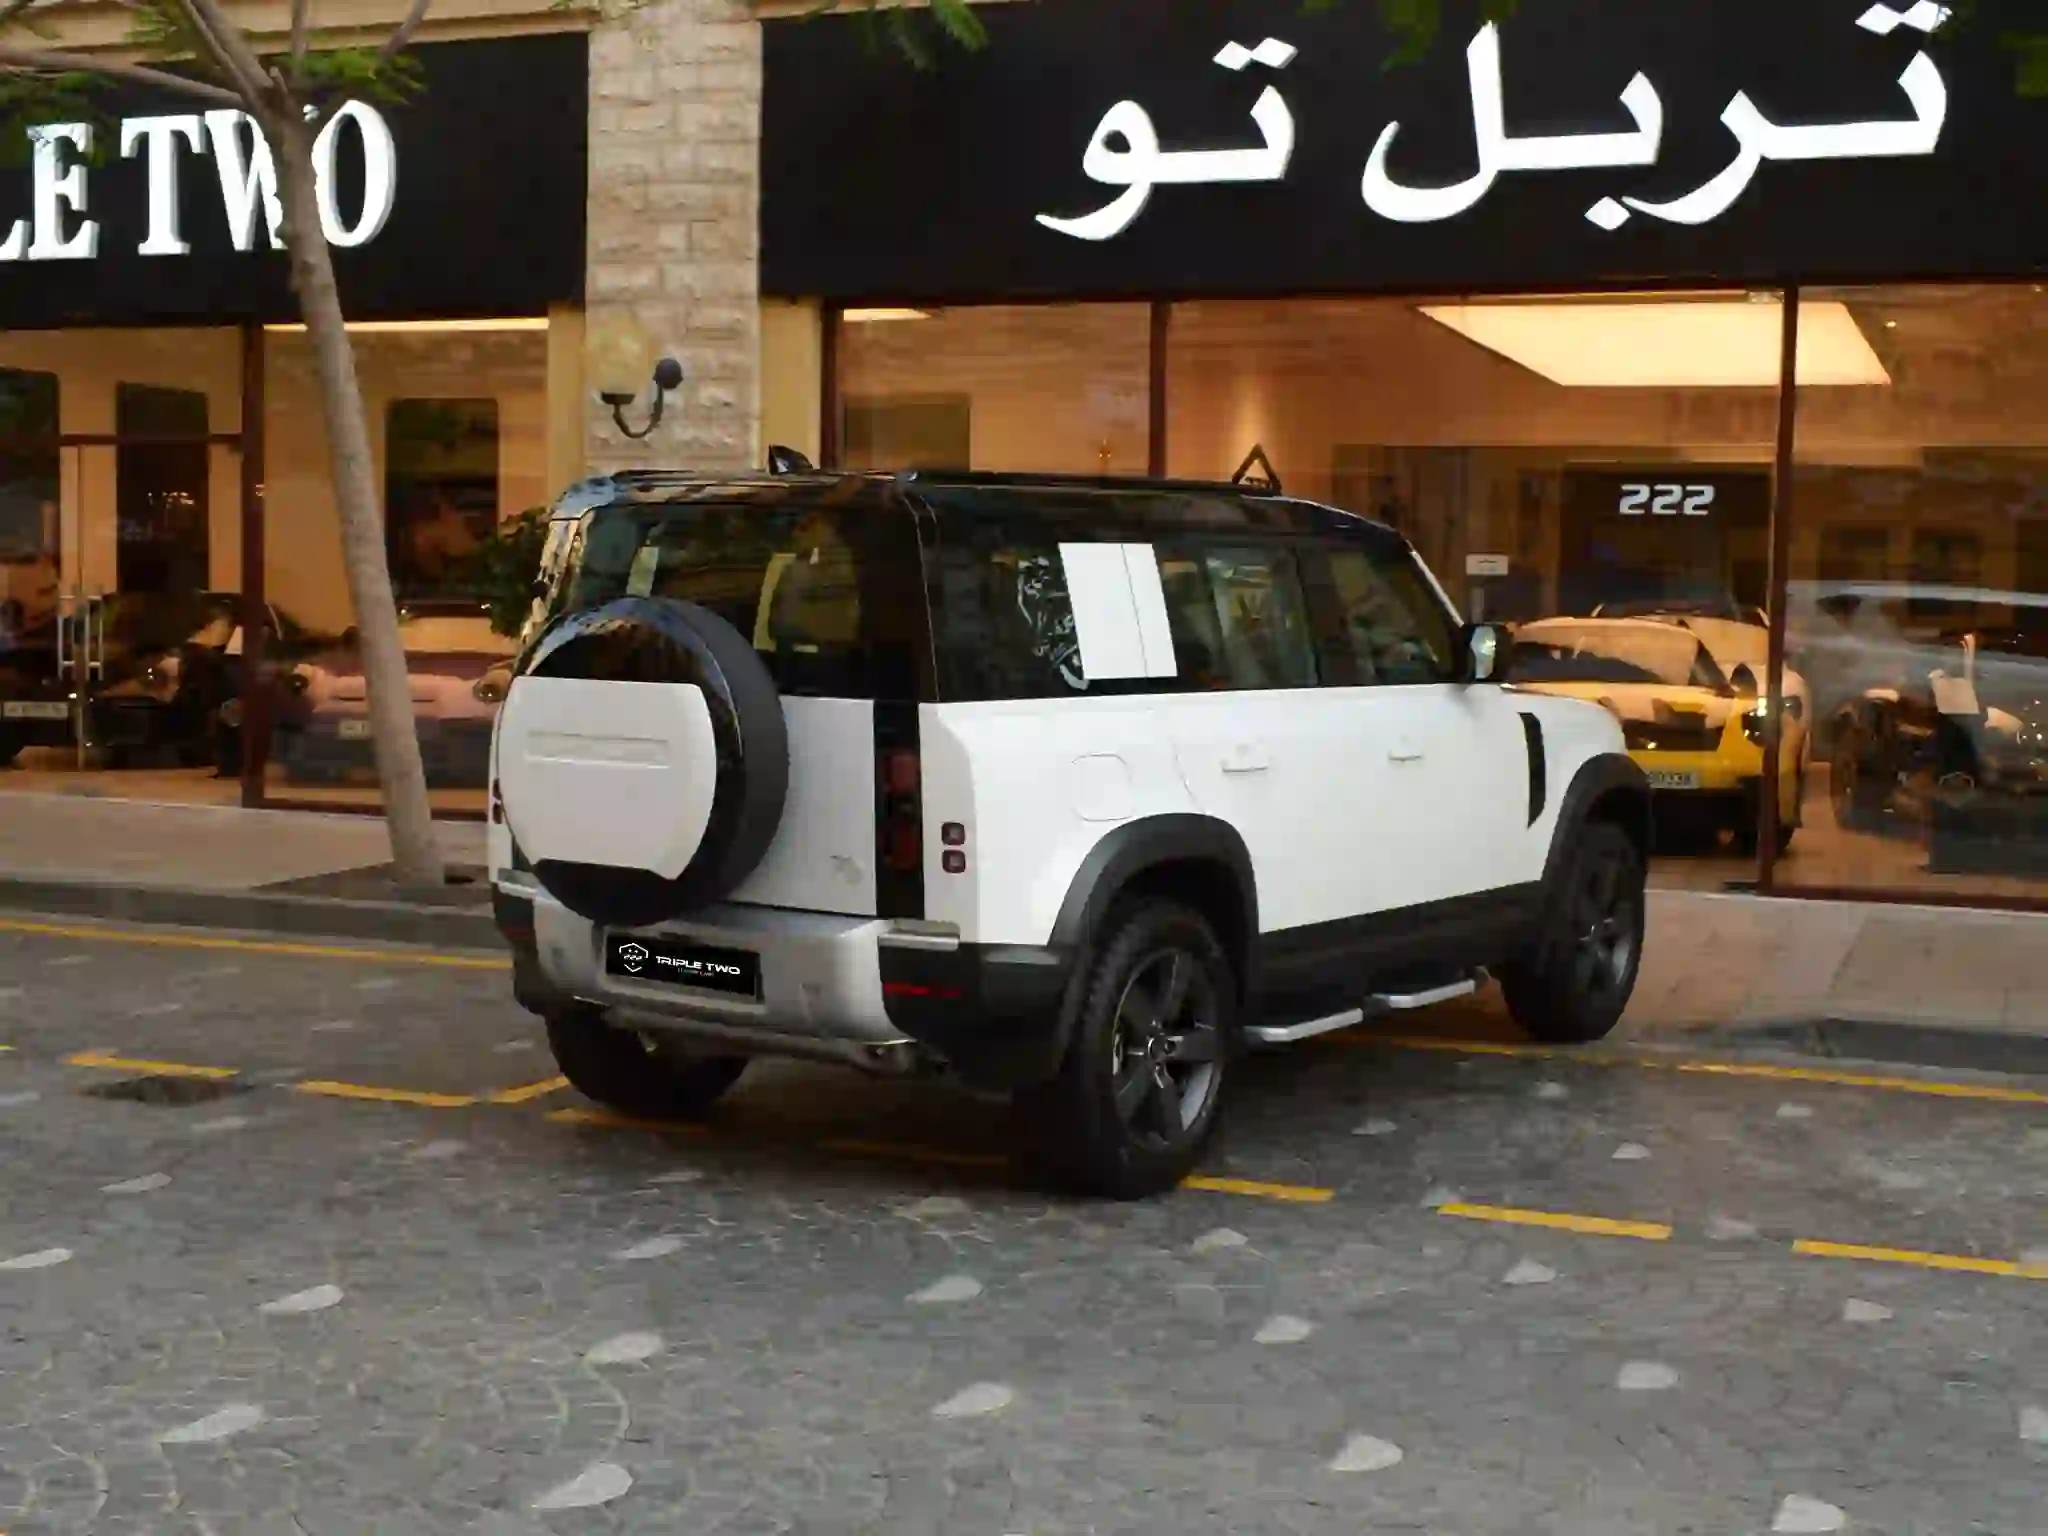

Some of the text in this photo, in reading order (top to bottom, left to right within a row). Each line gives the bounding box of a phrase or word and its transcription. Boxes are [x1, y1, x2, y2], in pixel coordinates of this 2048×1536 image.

[120, 99, 397, 256] TWO
[1034, 36, 1298, 241] تو
[1619, 484, 1716, 516] 222
[655, 955, 704, 970] TRIPLE
[705, 962, 741, 976] TWO
